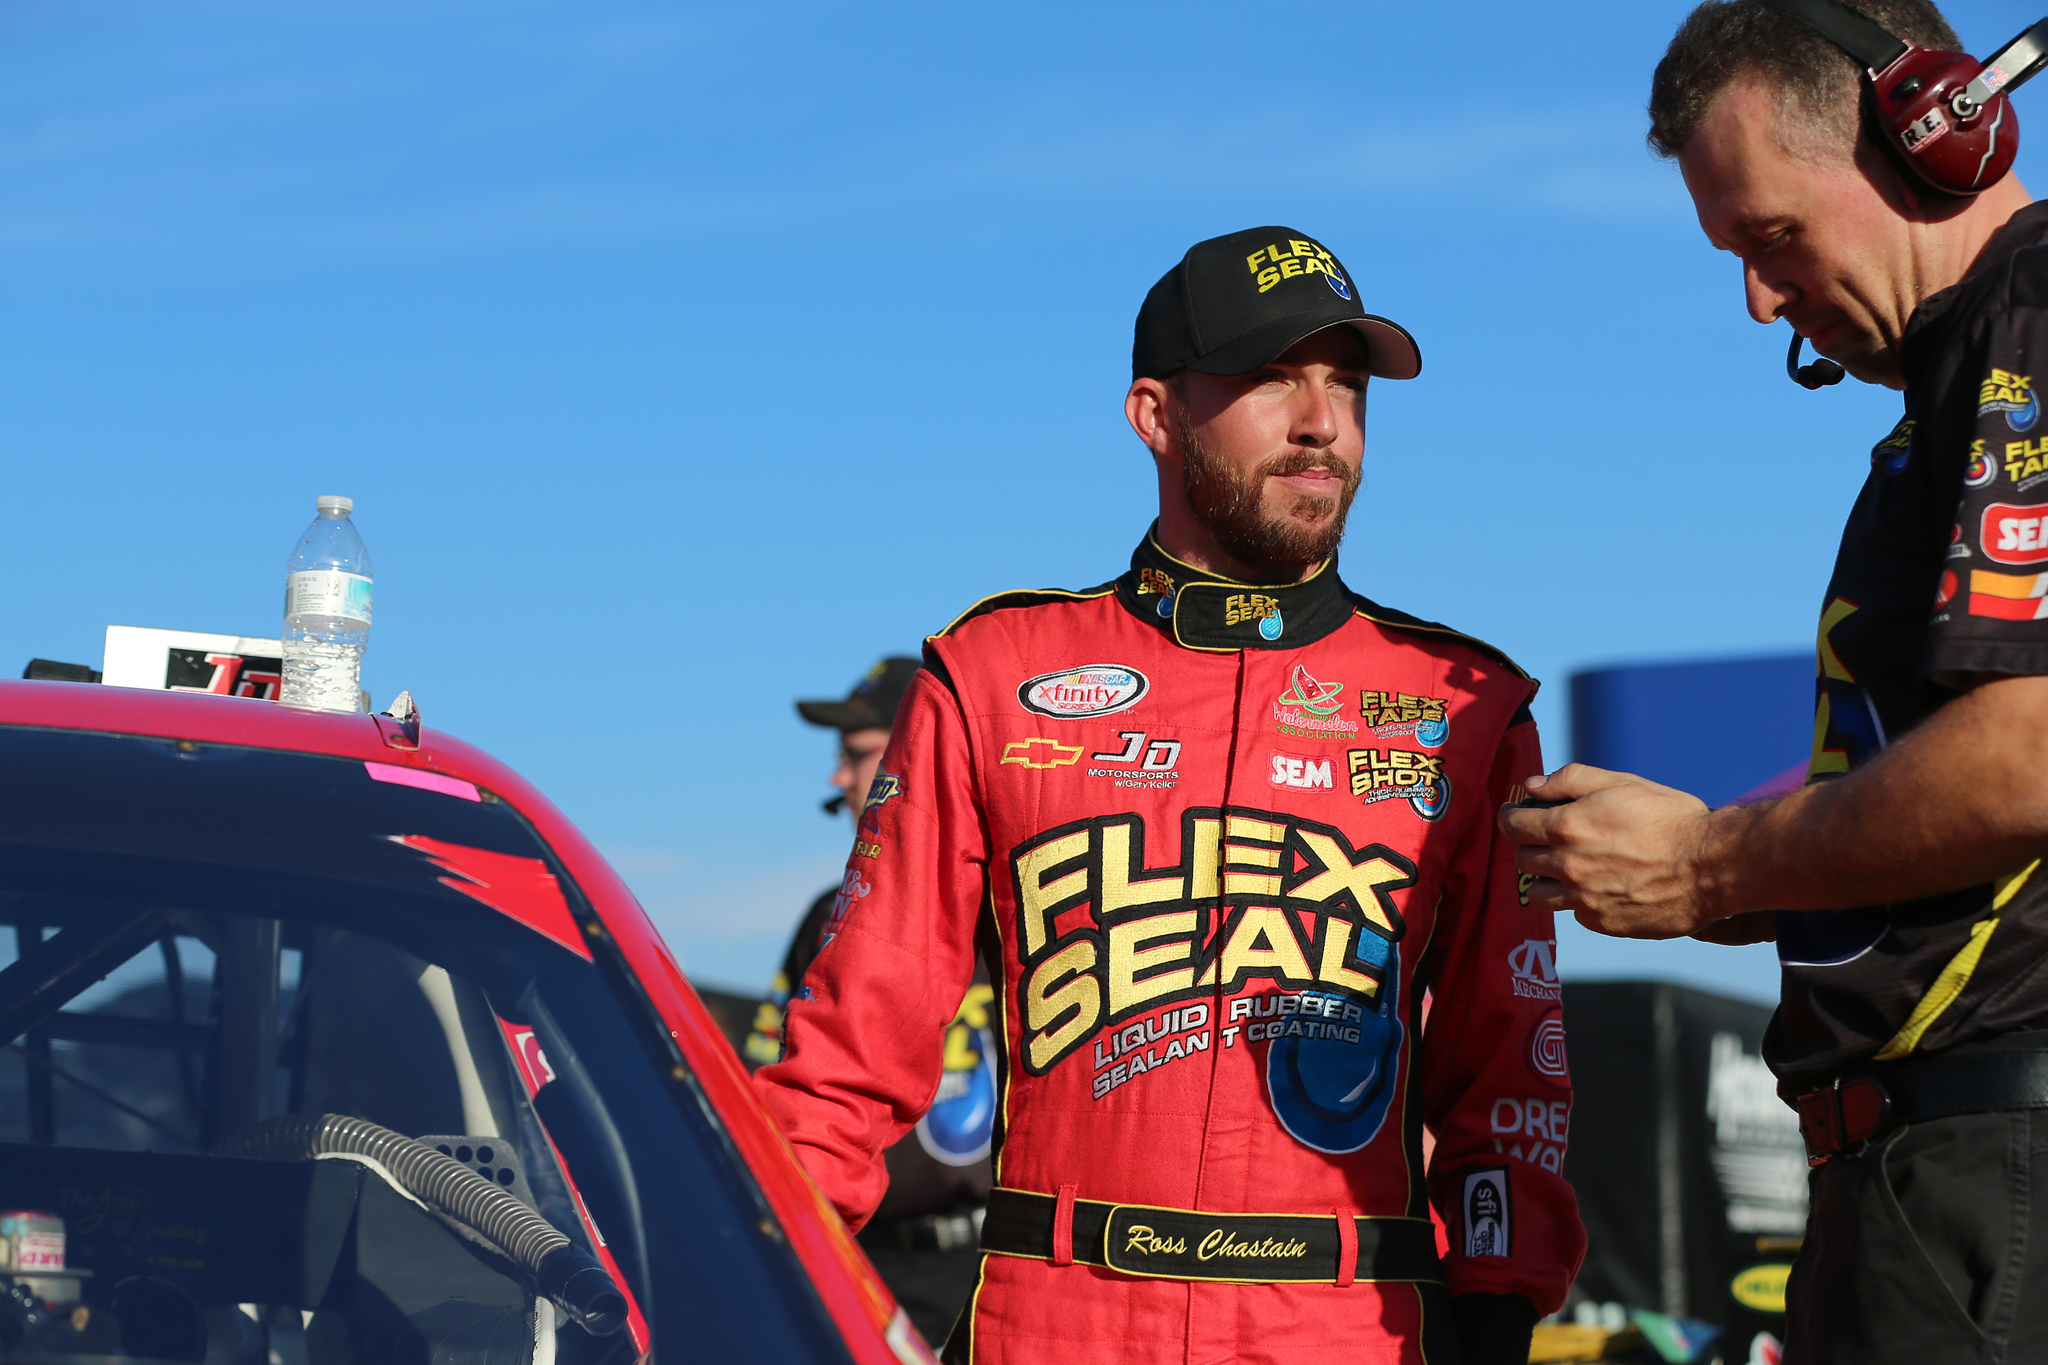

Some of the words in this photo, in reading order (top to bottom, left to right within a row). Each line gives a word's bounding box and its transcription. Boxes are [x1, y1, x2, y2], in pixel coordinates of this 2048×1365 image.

[1246, 239, 1337, 274] FLEX
[1257, 258, 1343, 294] SEAL
[1137, 581, 1172, 599] SEAL
[1140, 567, 1175, 591] FLEX
[1225, 594, 1279, 612] FLEX
[1225, 607, 1276, 627] SEAL
[1084, 674, 1129, 685] NASCAR
[1056, 702, 1096, 710] SERIES
[1360, 690, 1448, 712] FLEX
[1273, 702, 1359, 732] Watermelon
[1301, 711, 1334, 721] NATIONAL
[1359, 707, 1444, 728] TAPE
[1277, 723, 1356, 739] ASSOCIATION
[1091, 731, 1182, 771] JD
[1347, 748, 1445, 774] FLEX
[1088, 768, 1179, 780] MOTORSPORTS
[1271, 755, 1333, 789] SEM
[1350, 769, 1440, 797] SHOT
[1149, 780, 1177, 789] Keller
[1012, 808, 1414, 962] FLEX
[1024, 903, 1384, 1073] SEAL
[1094, 1003, 1208, 1071] LIQUID
[1230, 994, 1362, 1024] RUBBER
[1247, 1019, 1361, 1044] COATING
[1125, 1225, 1187, 1255] Ross
[1197, 1228, 1307, 1261] Chastain
